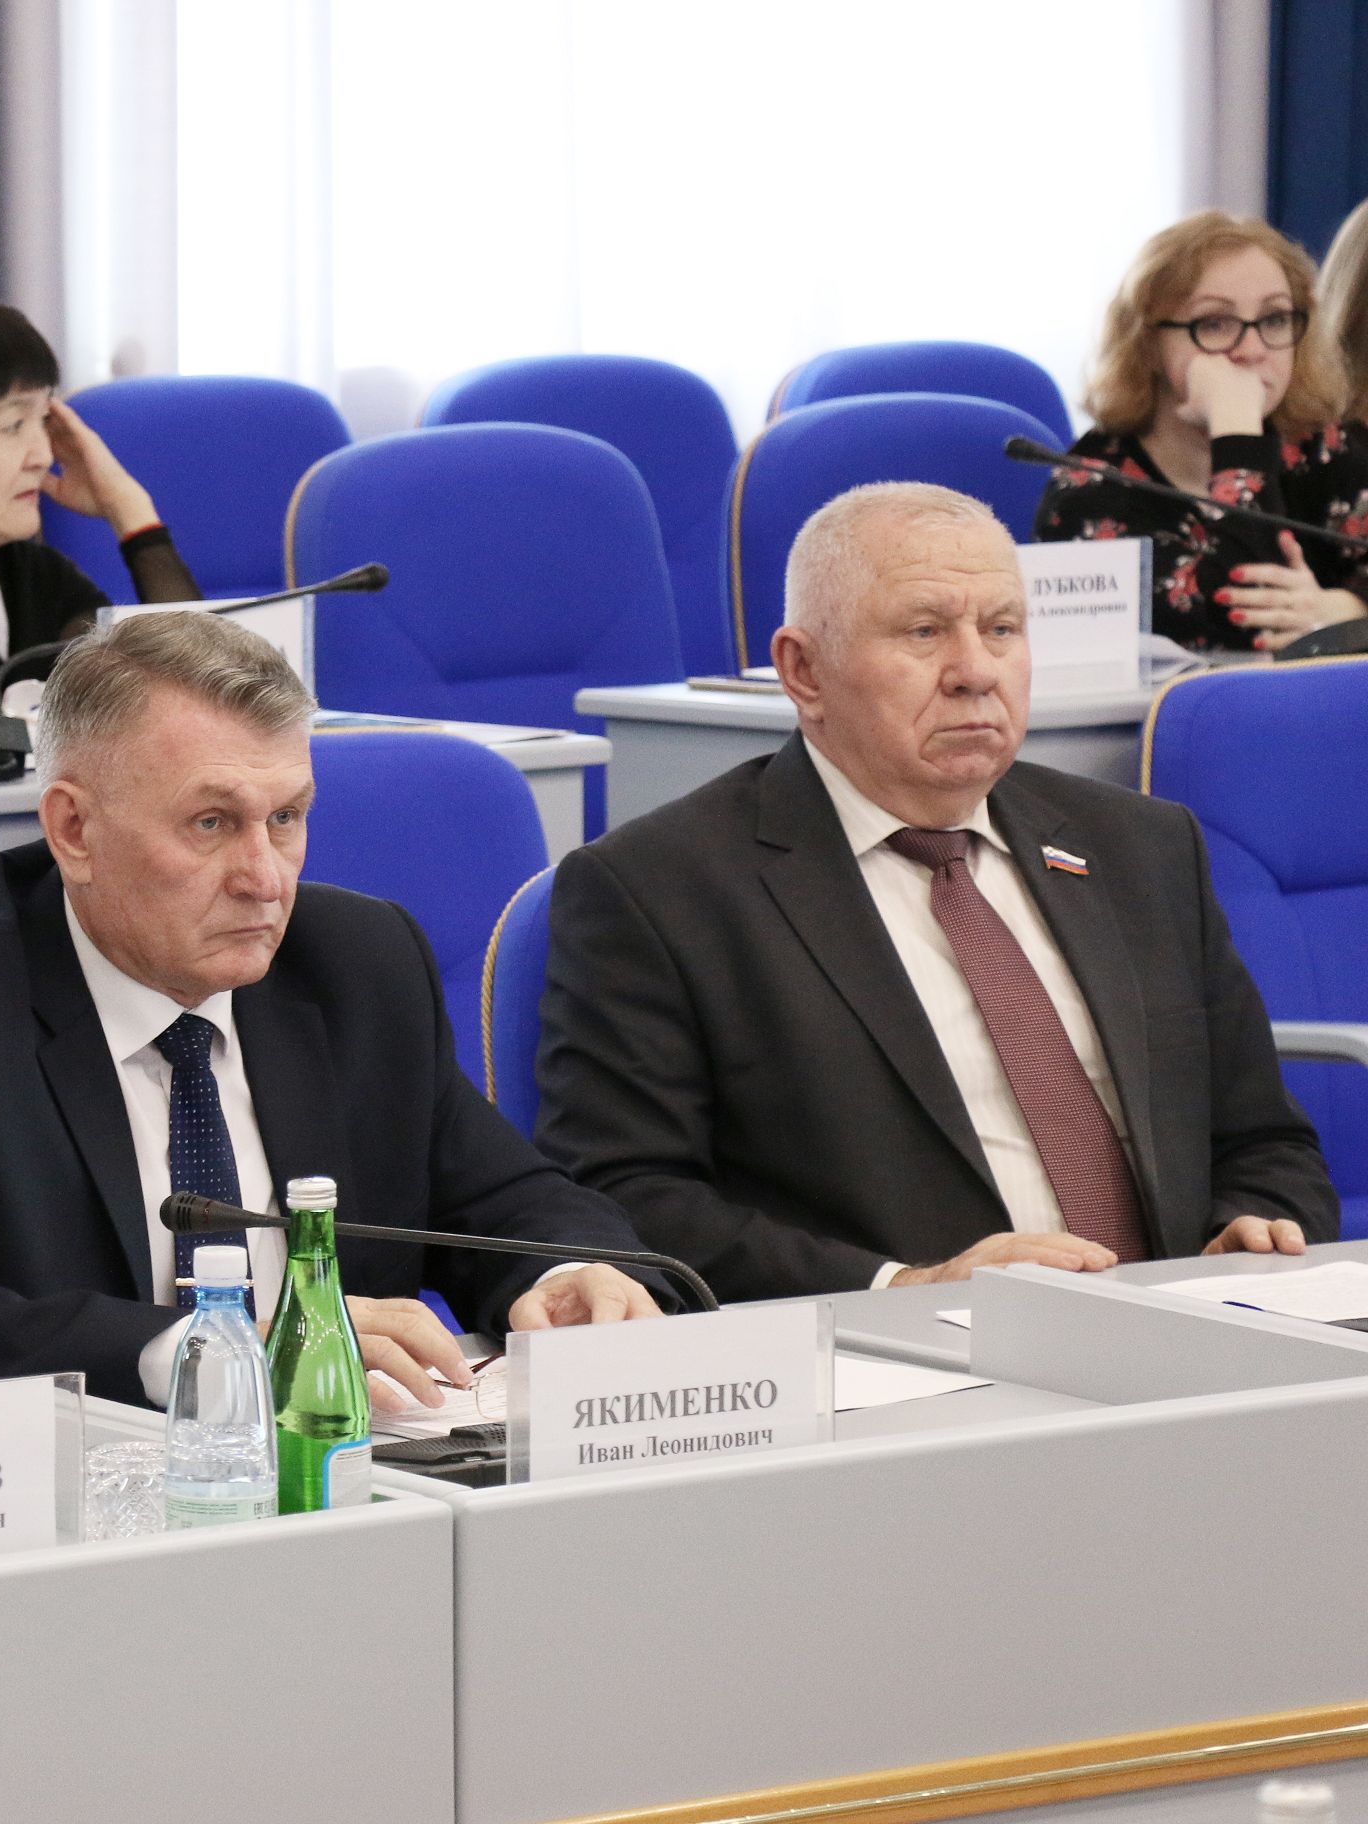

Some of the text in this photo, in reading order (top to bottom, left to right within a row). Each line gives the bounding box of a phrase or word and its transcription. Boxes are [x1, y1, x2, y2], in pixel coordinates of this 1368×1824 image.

[572, 1378, 779, 1430] ЯКИМЕНКО
[577, 1428, 774, 1466] Иван Леонидович
